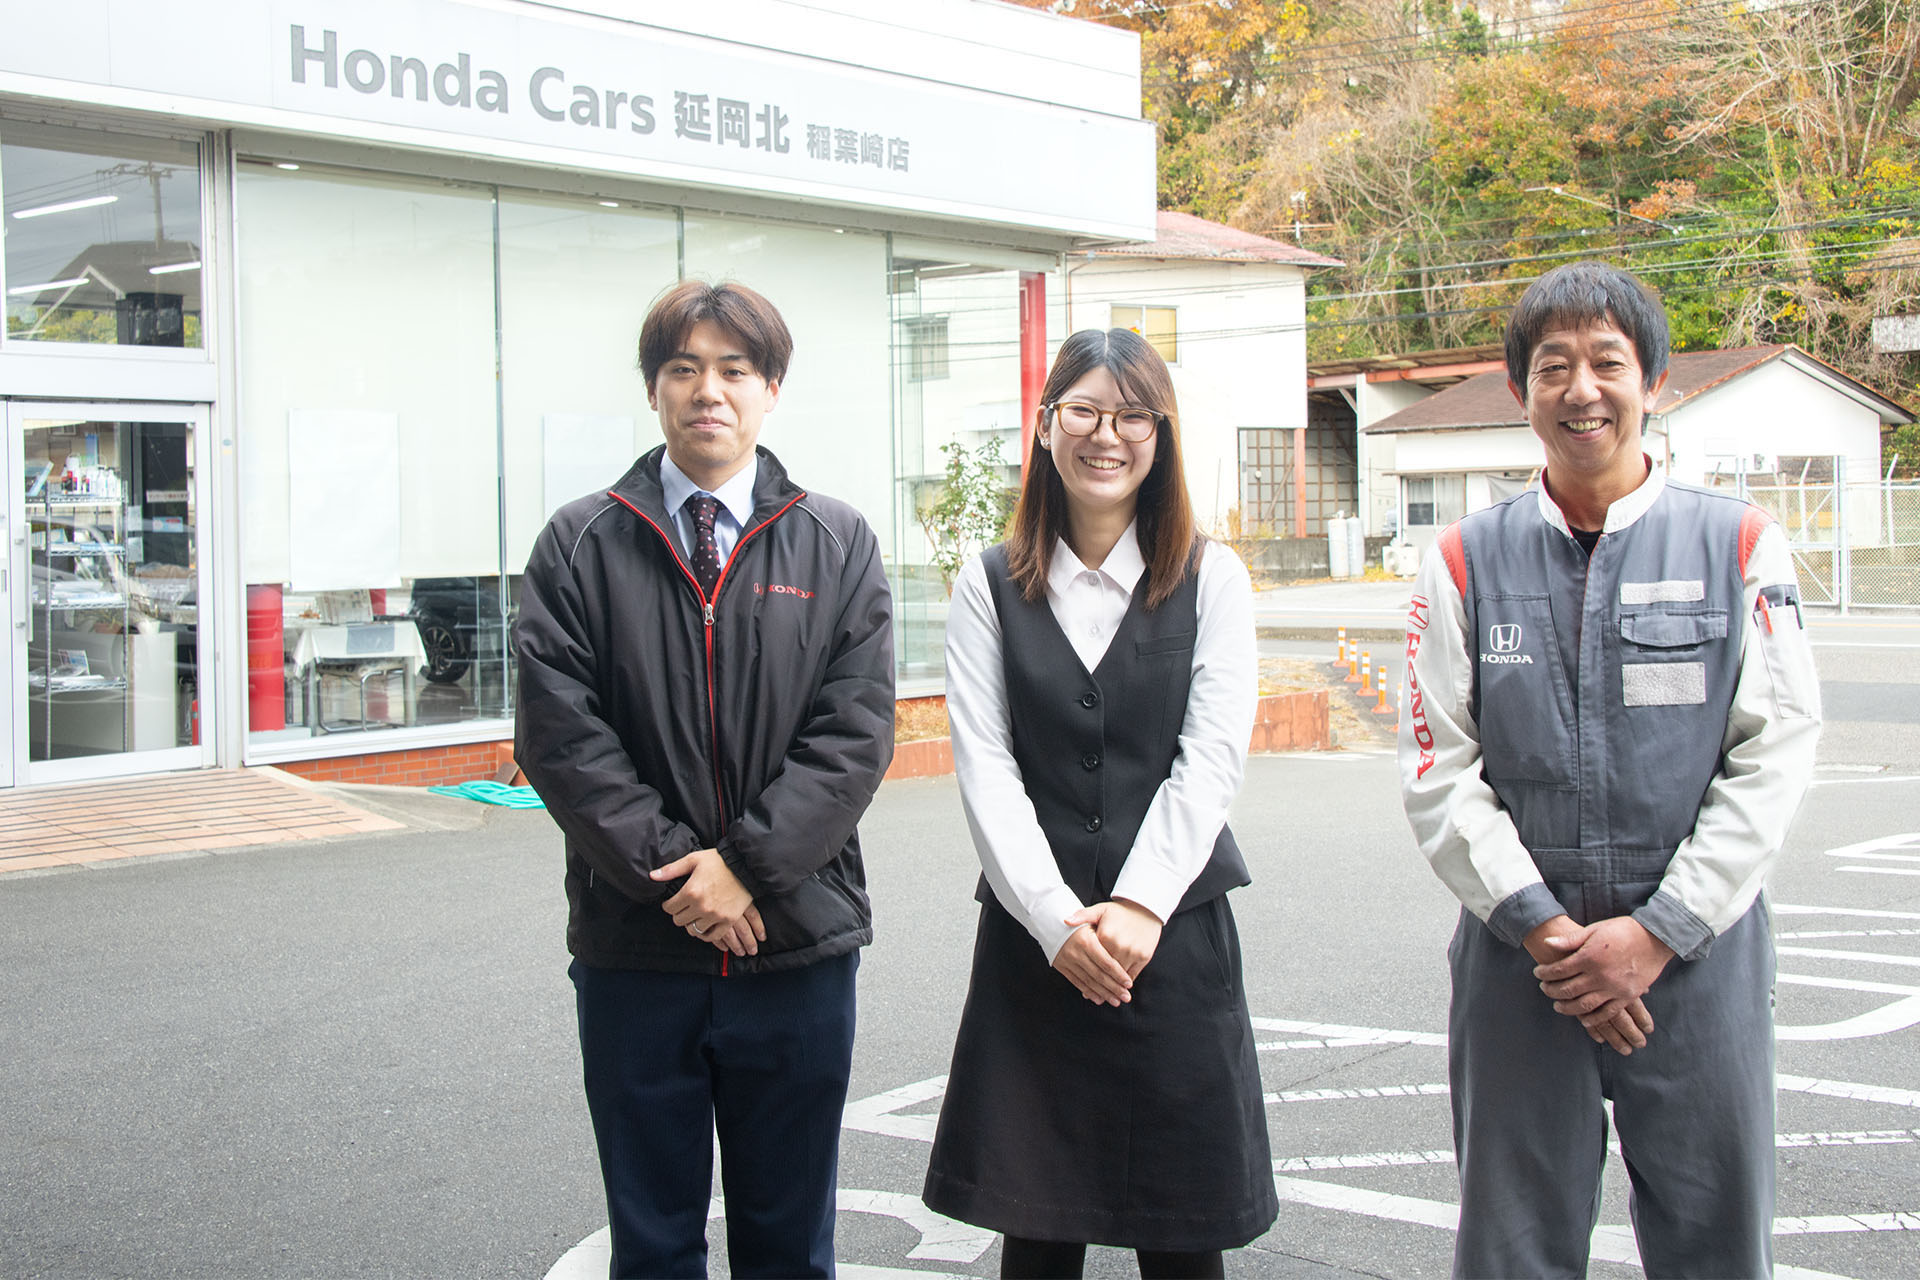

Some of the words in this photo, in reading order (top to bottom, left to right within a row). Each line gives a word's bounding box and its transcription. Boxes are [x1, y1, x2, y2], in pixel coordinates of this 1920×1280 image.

[290, 24, 509, 113] Honda
[529, 66, 656, 135] Cars
[674, 90, 791, 154] 延岡北
[806, 123, 910, 173] 稲葉崎店
[1406, 632, 1436, 780] HONDA
